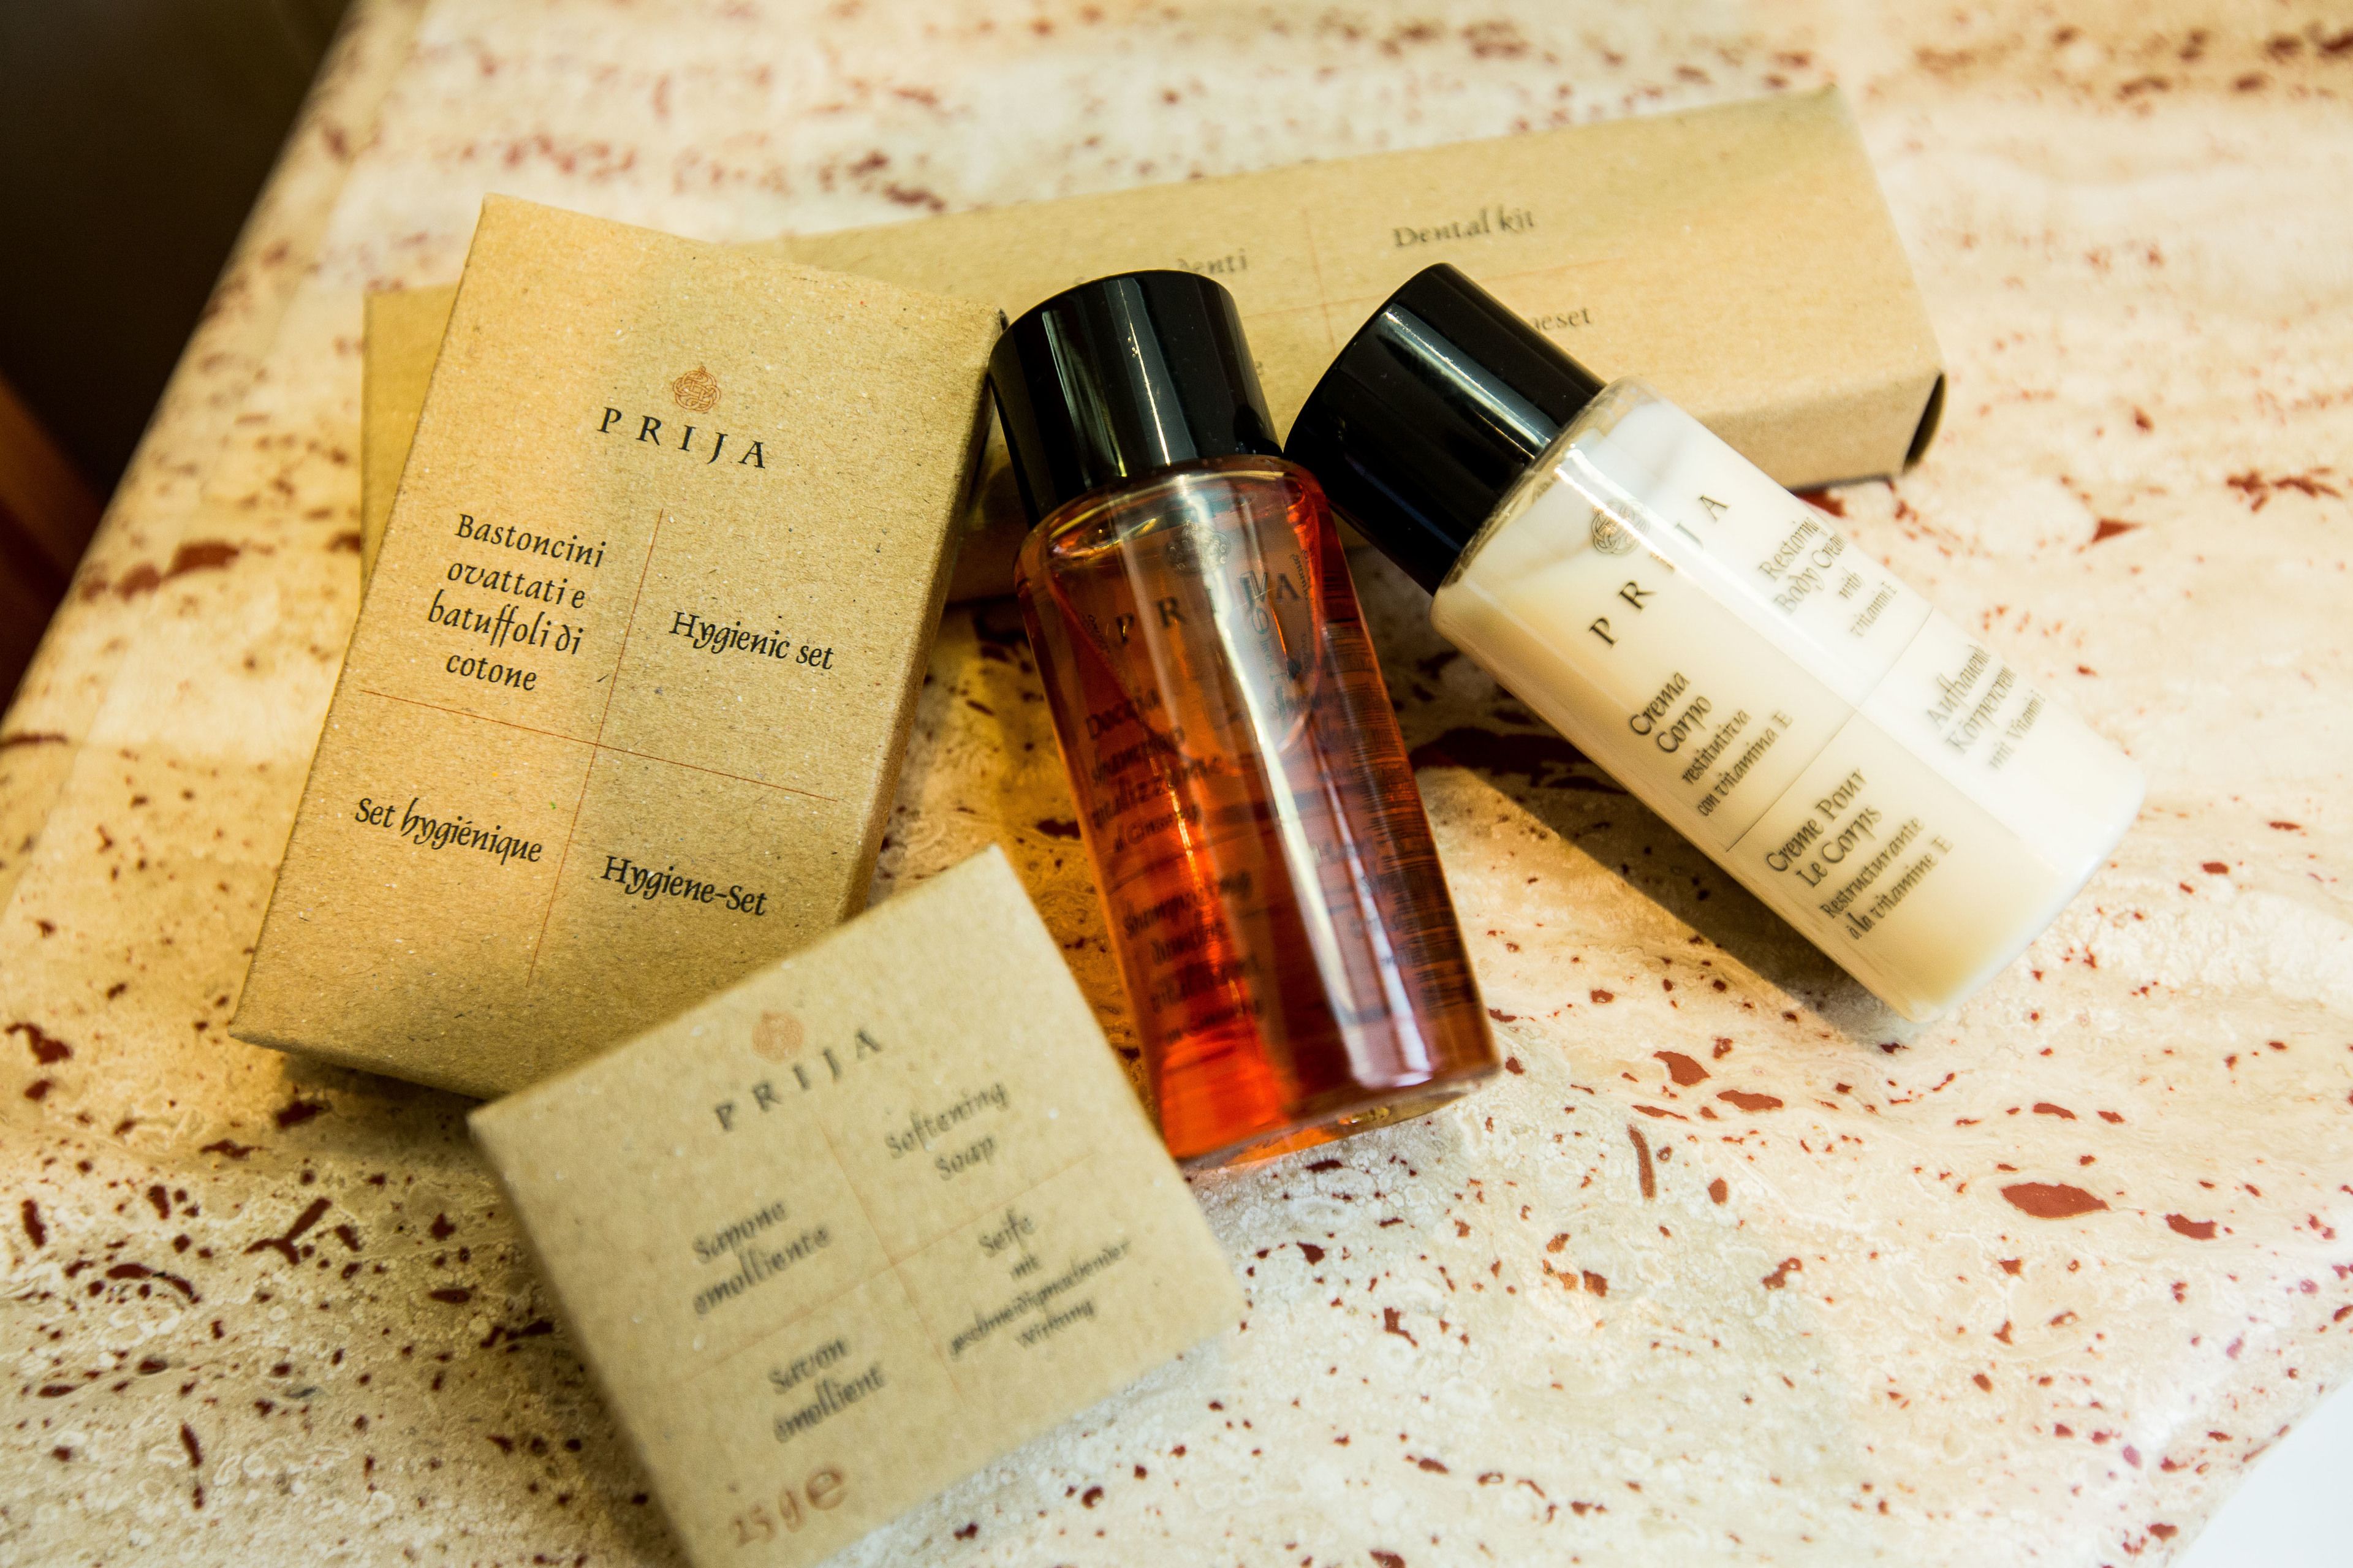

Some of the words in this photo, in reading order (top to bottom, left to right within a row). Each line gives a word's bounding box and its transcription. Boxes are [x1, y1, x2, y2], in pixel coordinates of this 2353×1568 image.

[1392, 205, 1490, 248] Dental
[1497, 205, 1534, 233] kit
[596, 406, 767, 470] PRIJA
[453, 513, 607, 569] Bastoncini
[1758, 515, 1829, 582] Restoring
[447, 562, 567, 605] ovattati
[570, 589, 586, 610] e
[1773, 560, 1826, 616] Body
[427, 589, 550, 650] batuffoli
[554, 620, 585, 657] di
[669, 611, 790, 659] Hygienic
[795, 643, 834, 671] set
[445, 649, 537, 692] cotone
[1629, 671, 1691, 737] Crema
[1656, 695, 1712, 754] Corpo
[1681, 708, 1752, 786] restitutiva
[1698, 793, 1721, 817] con
[1715, 725, 1779, 797] vitamina
[1773, 710, 1793, 730] E
[354, 798, 396, 829] Set
[400, 797, 544, 865] hygiénique
[1765, 819, 1825, 873] Creme
[1815, 767, 1868, 824] Pour
[1795, 860, 1828, 888] Le
[1822, 804, 1883, 866] Corps
[601, 856, 768, 917] Hygiene-Set
[1847, 910, 1875, 933] la
[1870, 852, 1938, 920] vitamine
[1931, 835, 1953, 855] E
[714, 1028, 882, 1132] PRIJA
[885, 1080, 1010, 1159] Softening
[934, 1134, 998, 1181] Soap
[692, 1201, 787, 1265] Sapone
[767, 1336, 851, 1396] Savon
[774, 1362, 885, 1444] emollient
